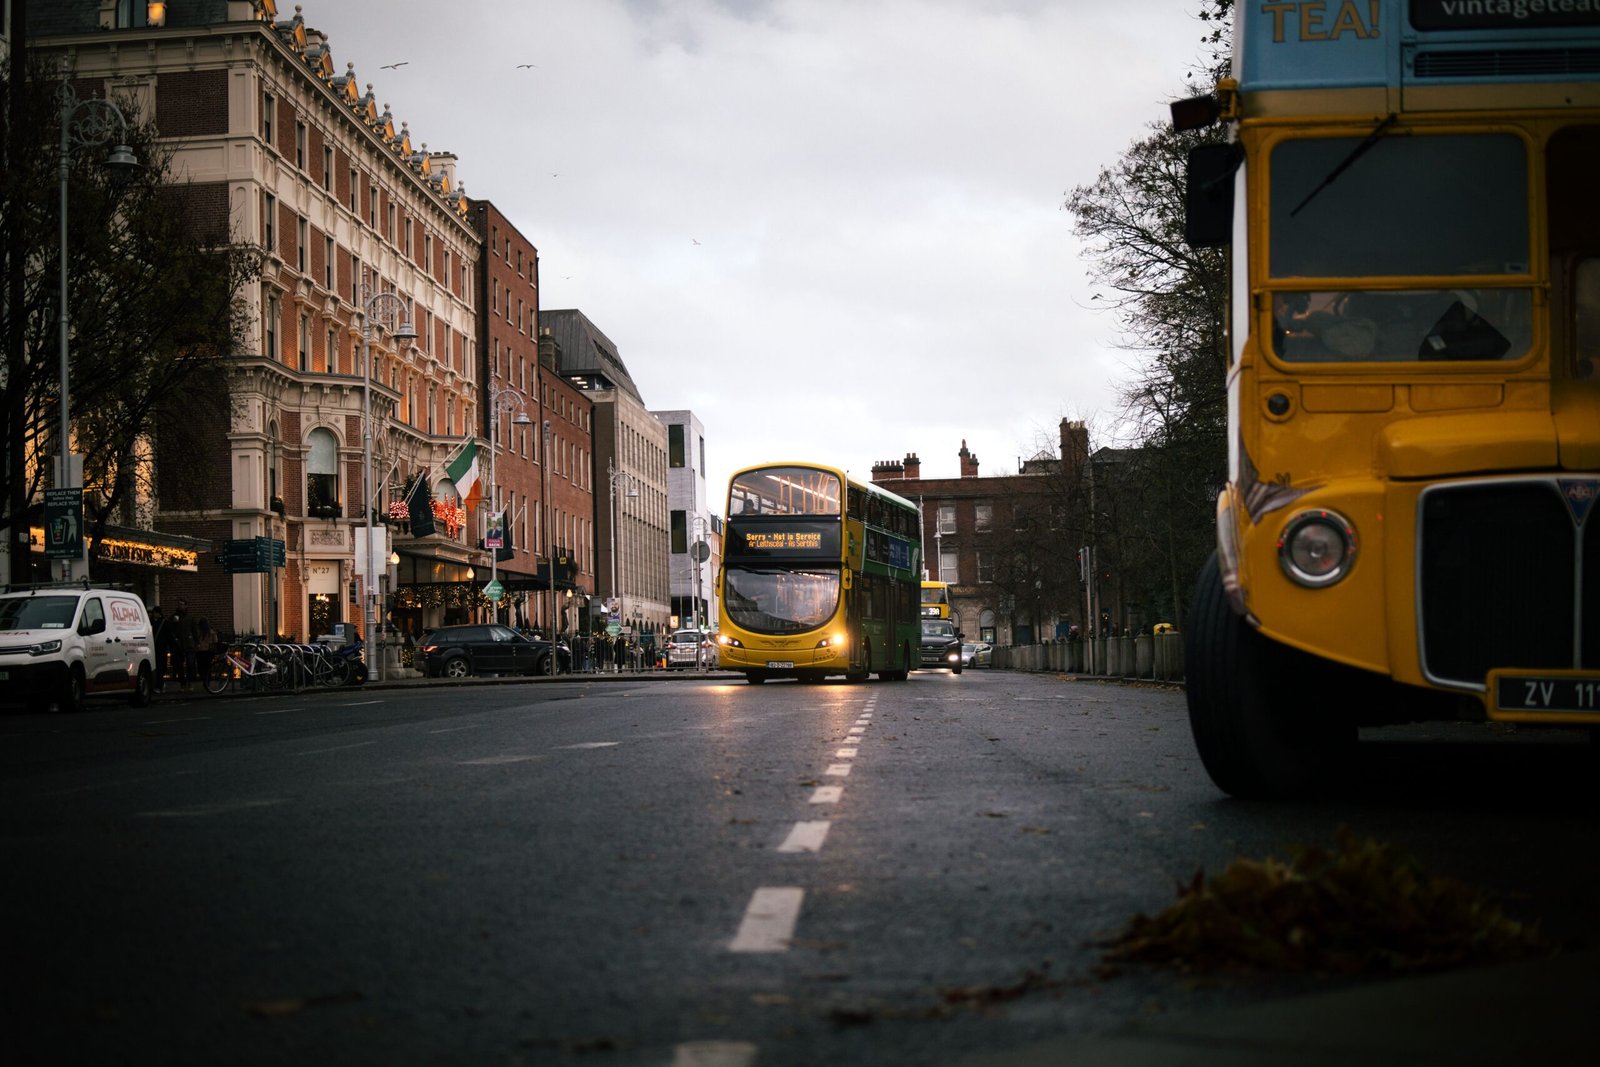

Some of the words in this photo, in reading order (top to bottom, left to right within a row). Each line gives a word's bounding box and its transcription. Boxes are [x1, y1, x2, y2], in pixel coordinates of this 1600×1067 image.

[1261, 0, 1380, 43] TEA!
[746, 533, 766, 541] Sorry
[112, 606, 141, 622] ALPHA
[928, 607, 940, 616] 39A
[1524, 681, 1555, 706] ZV
